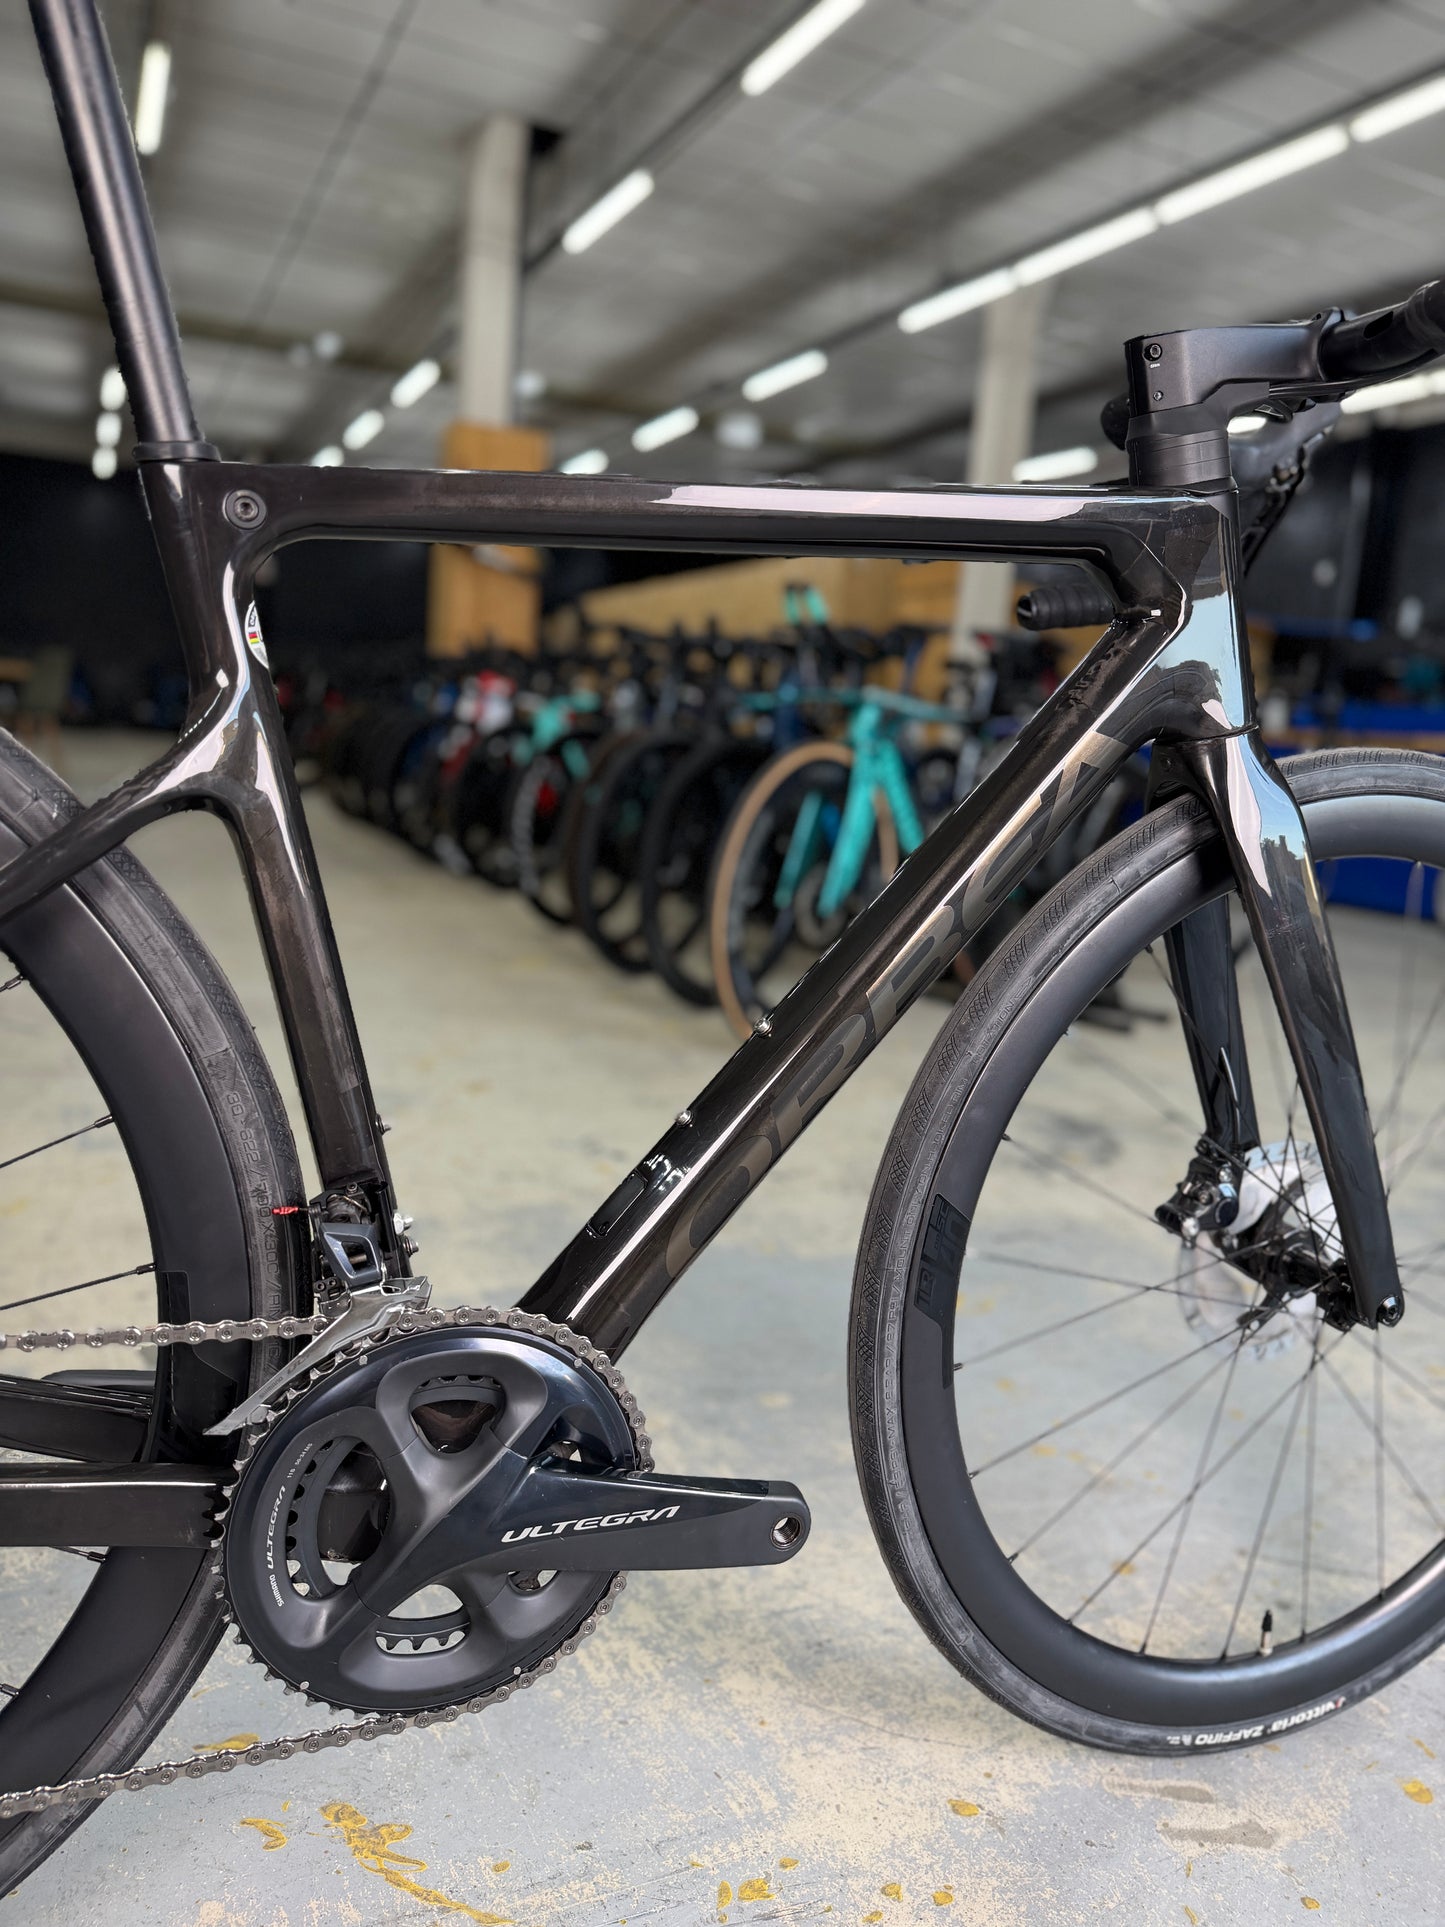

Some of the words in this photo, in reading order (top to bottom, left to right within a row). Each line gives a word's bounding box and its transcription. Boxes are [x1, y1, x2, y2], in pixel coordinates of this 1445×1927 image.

[666, 730, 1128, 1278] ORBEA
[266, 1485, 286, 1570] ULTEGRA
[501, 1505, 681, 1543] ULTEGRA
[269, 1574, 285, 1607] SHIMANO
[1271, 1700, 1336, 1733] vittoria
[1194, 1724, 1265, 1746] ZAFFIRO
